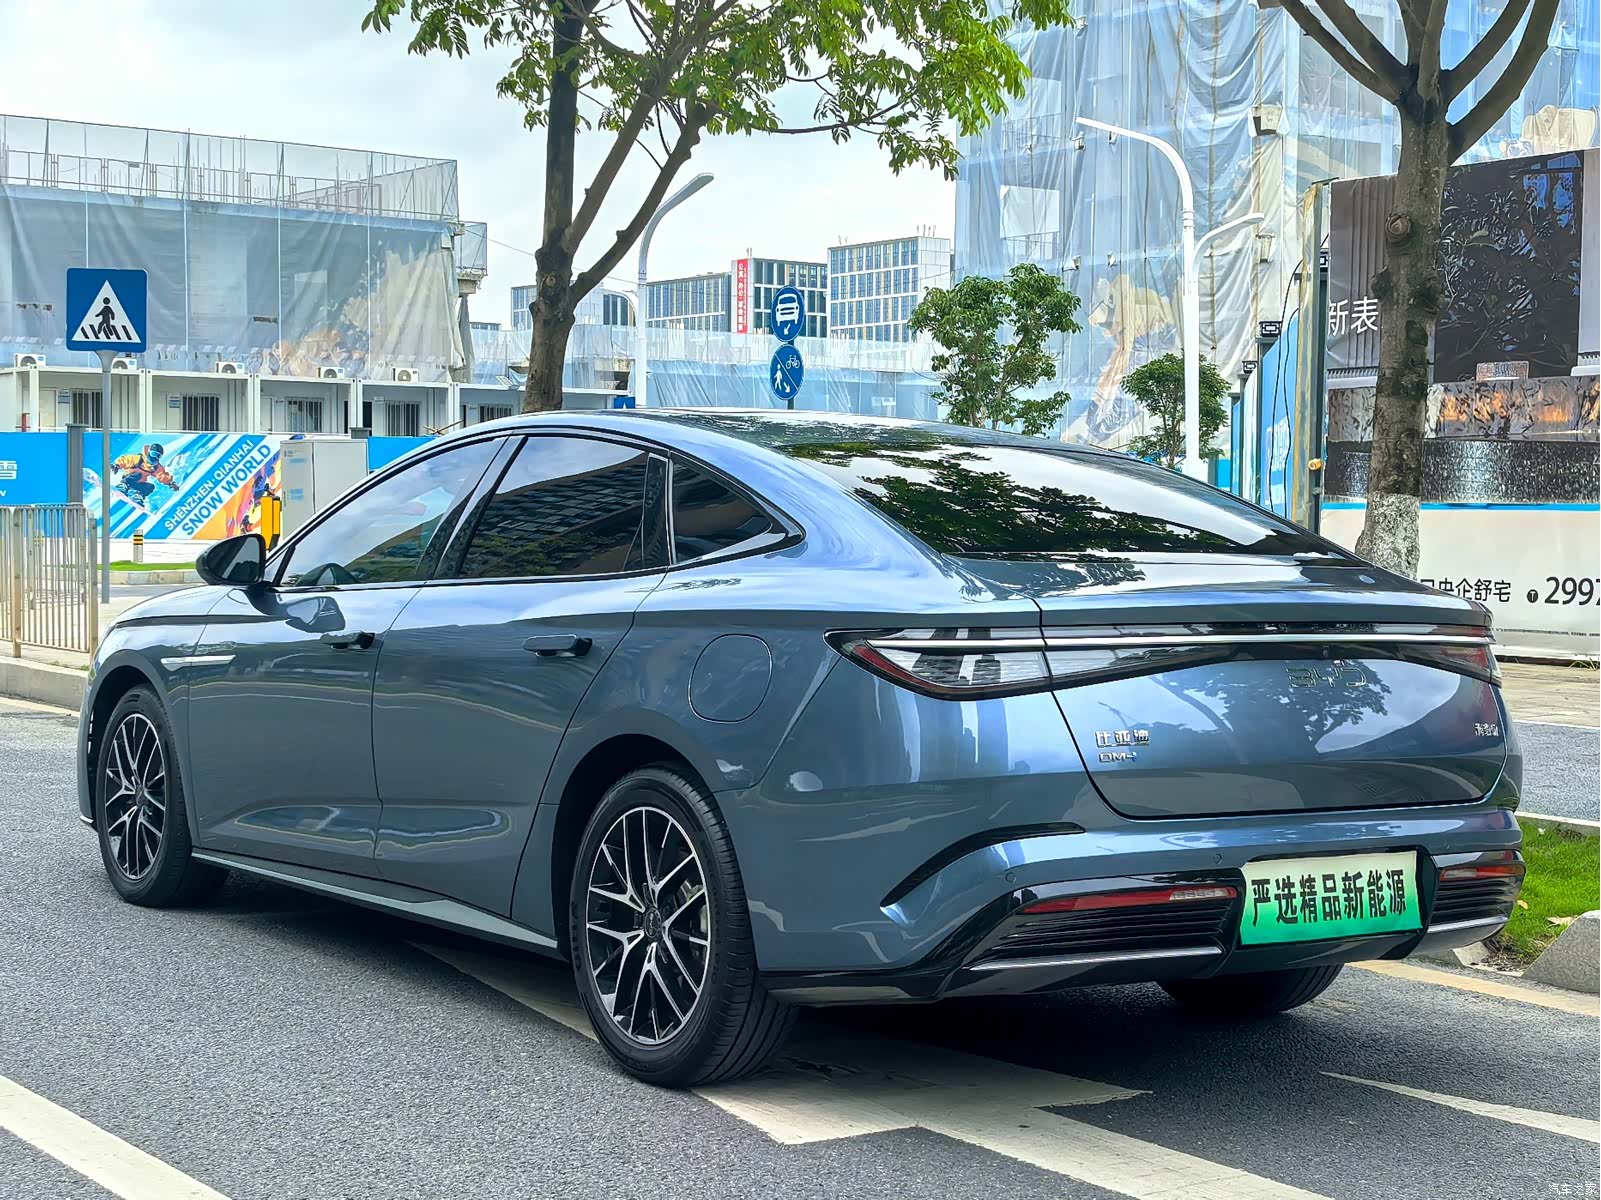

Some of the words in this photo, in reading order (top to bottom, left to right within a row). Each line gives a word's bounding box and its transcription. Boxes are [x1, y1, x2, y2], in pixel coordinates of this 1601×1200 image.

[1328, 296, 1379, 336] 新表
[182, 491, 224, 536] SNOW
[221, 444, 271, 495] WORLD
[1286, 666, 1367, 688] BYD
[1251, 869, 1407, 927] 严选精品新能源
